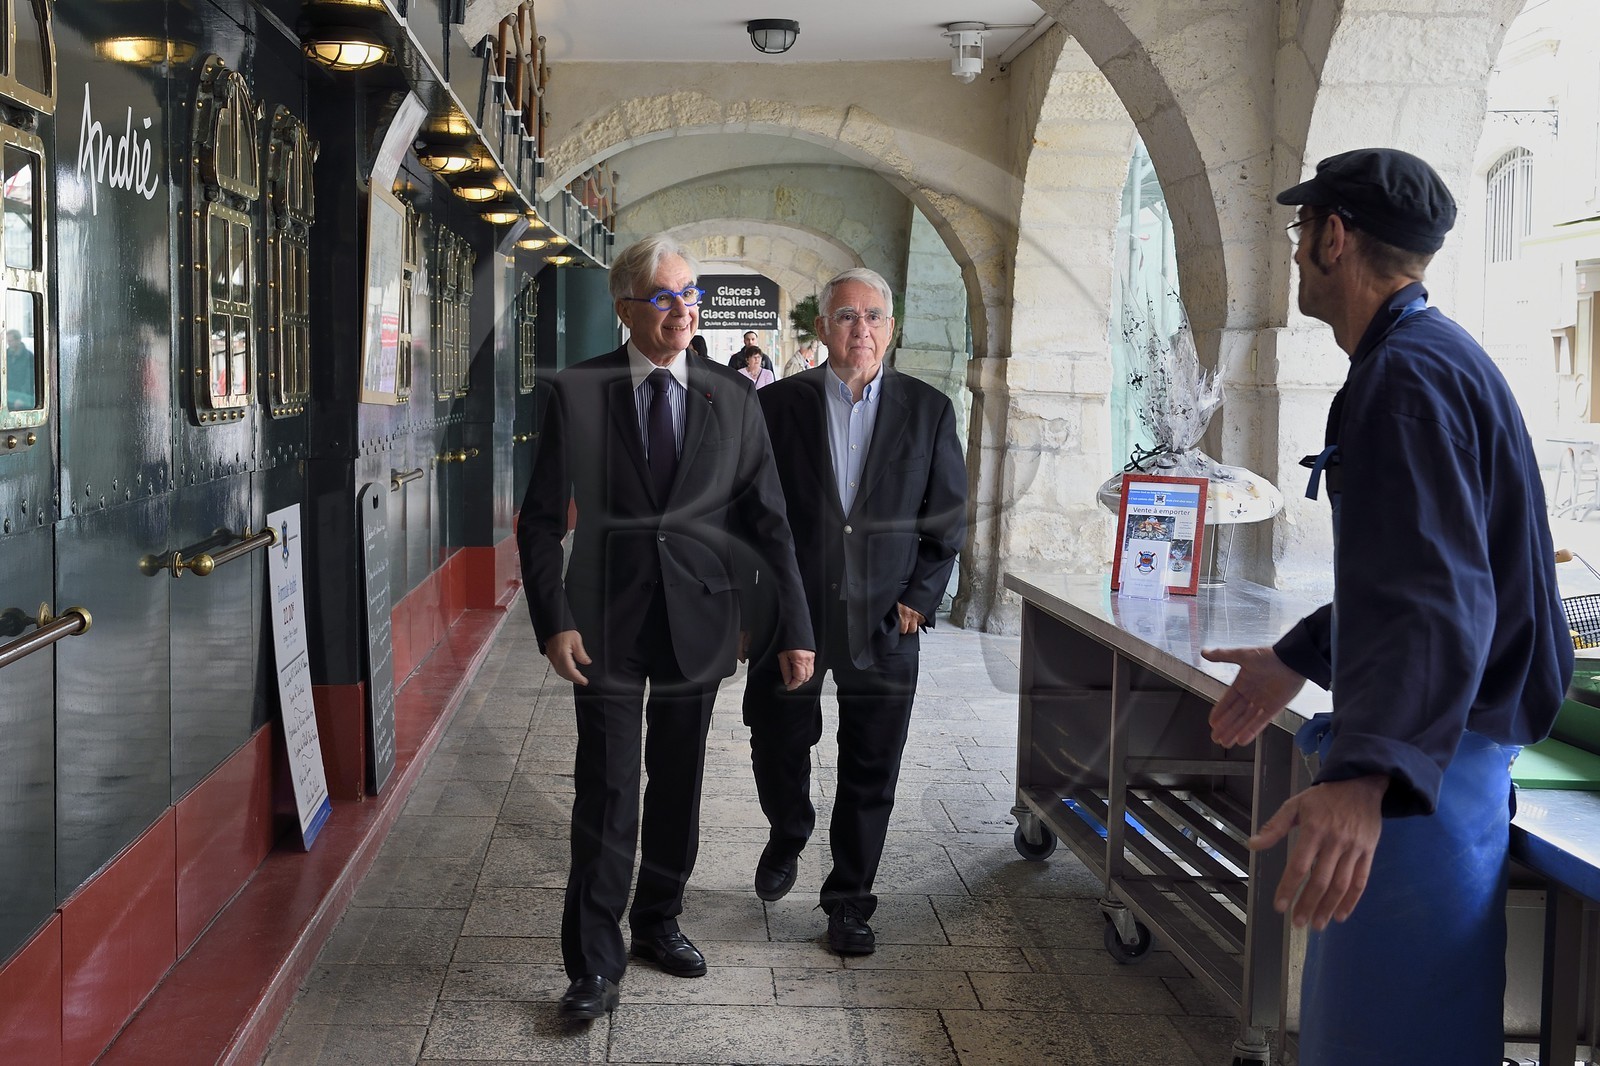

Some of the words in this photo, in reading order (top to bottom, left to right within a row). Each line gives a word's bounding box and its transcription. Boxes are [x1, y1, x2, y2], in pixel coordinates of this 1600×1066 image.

[76, 81, 159, 216] André
[717, 286, 752, 296] Glaces
[753, 286, 761, 296] à
[711, 296, 766, 307] l'italienne
[701, 309, 736, 319] Glaces
[737, 309, 777, 319] maison
[1158, 508, 1191, 516] emporter
